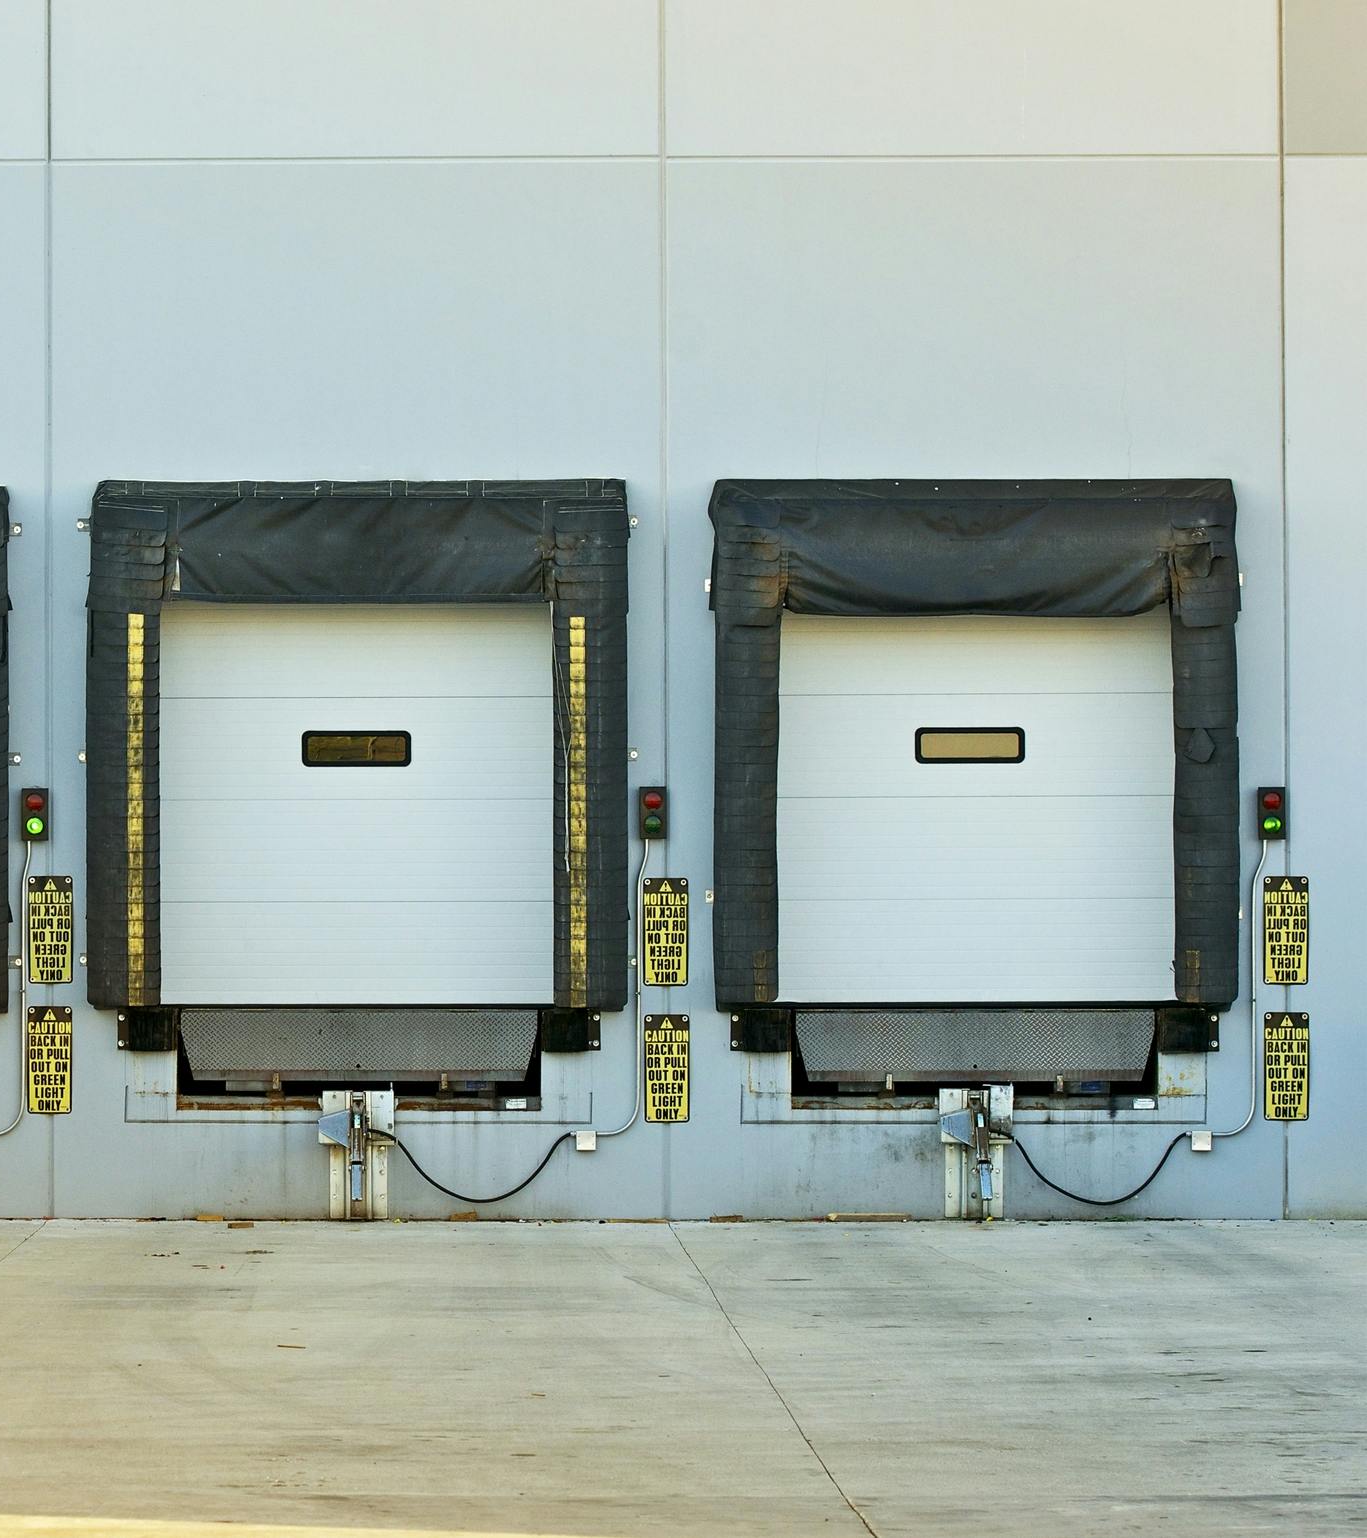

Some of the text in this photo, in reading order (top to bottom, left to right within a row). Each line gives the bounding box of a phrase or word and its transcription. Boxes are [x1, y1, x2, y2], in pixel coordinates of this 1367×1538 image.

[29, 1022, 71, 1033] CAUTION
[645, 1031, 688, 1041] CAUTION
[1265, 1028, 1308, 1040] CAUTION
[31, 1036, 69, 1046] BACK IN
[648, 1044, 686, 1055] BACK IN
[1268, 1042, 1306, 1052] BACK IN
[30, 1049, 69, 1059] OR PULL
[647, 1057, 686, 1068] OR PULL
[1267, 1055, 1306, 1066] OR PULL
[32, 1062, 68, 1072] OUT ON
[648, 1070, 685, 1081] OUT ON
[1268, 1068, 1305, 1078] OUT ON
[34, 1075, 65, 1085] GREEN
[651, 1083, 683, 1094] GREEN
[1271, 1081, 1302, 1092] GREEN
[36, 1087, 65, 1098] LIGHT
[38, 1100, 61, 1110] ONLY
[653, 1096, 682, 1107] LIGHT
[1272, 1094, 1302, 1105] LIGHT
[656, 1109, 679, 1119] ONLY
[1275, 1106, 1298, 1117] ONLY
